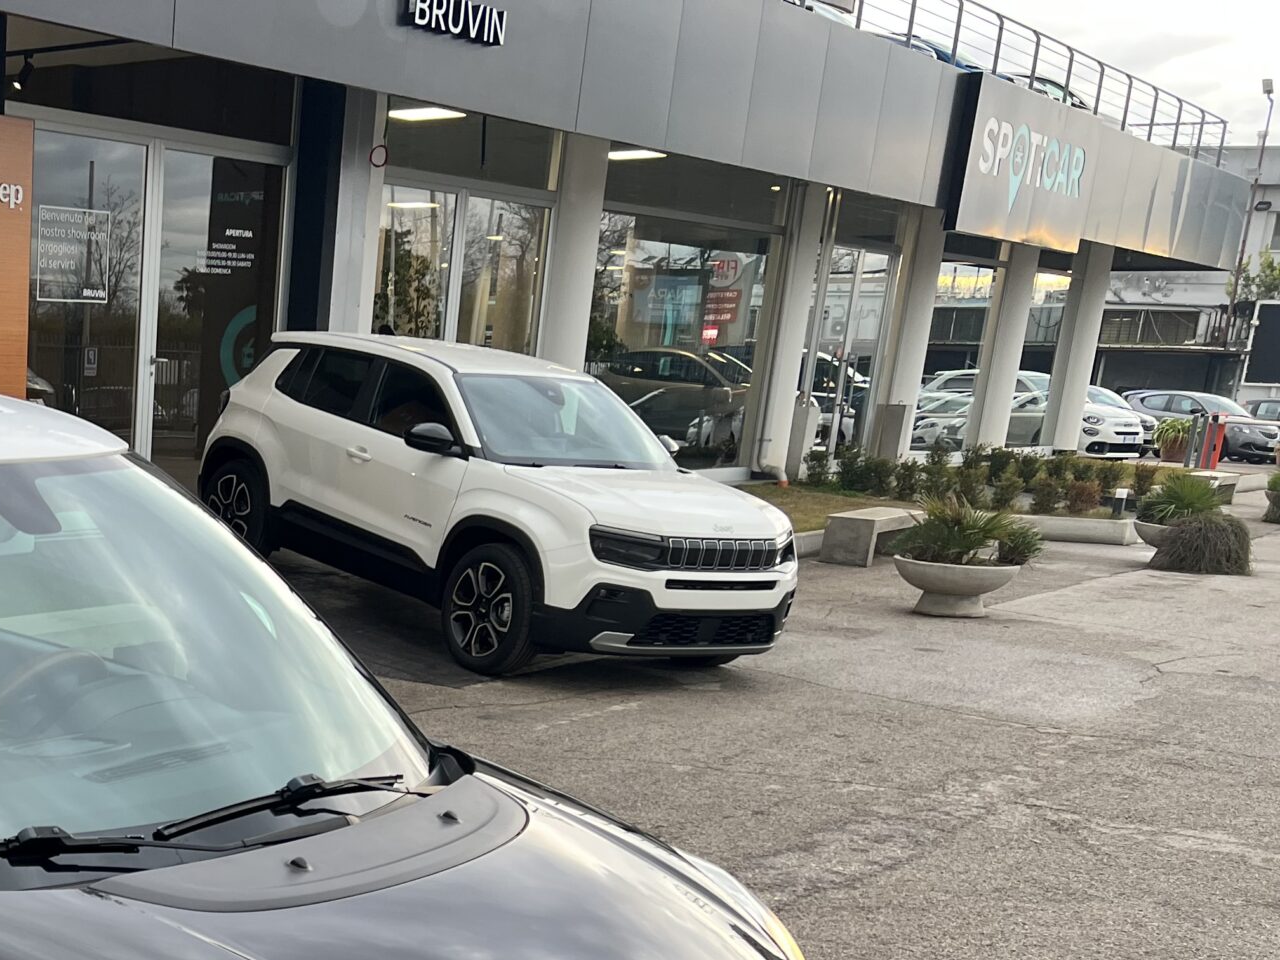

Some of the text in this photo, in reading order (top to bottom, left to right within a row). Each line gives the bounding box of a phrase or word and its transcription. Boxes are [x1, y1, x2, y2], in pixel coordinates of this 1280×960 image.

[415, 0, 507, 46] BRUVIN
[41, 209, 83, 224] Benvenuto
[40, 227, 107, 240] nostro showroom
[225, 229, 253, 238] APERTURA
[40, 243, 78, 256] orgogliosi
[40, 258, 76, 270] di servirti
[82, 288, 106, 298] BRUVIN
